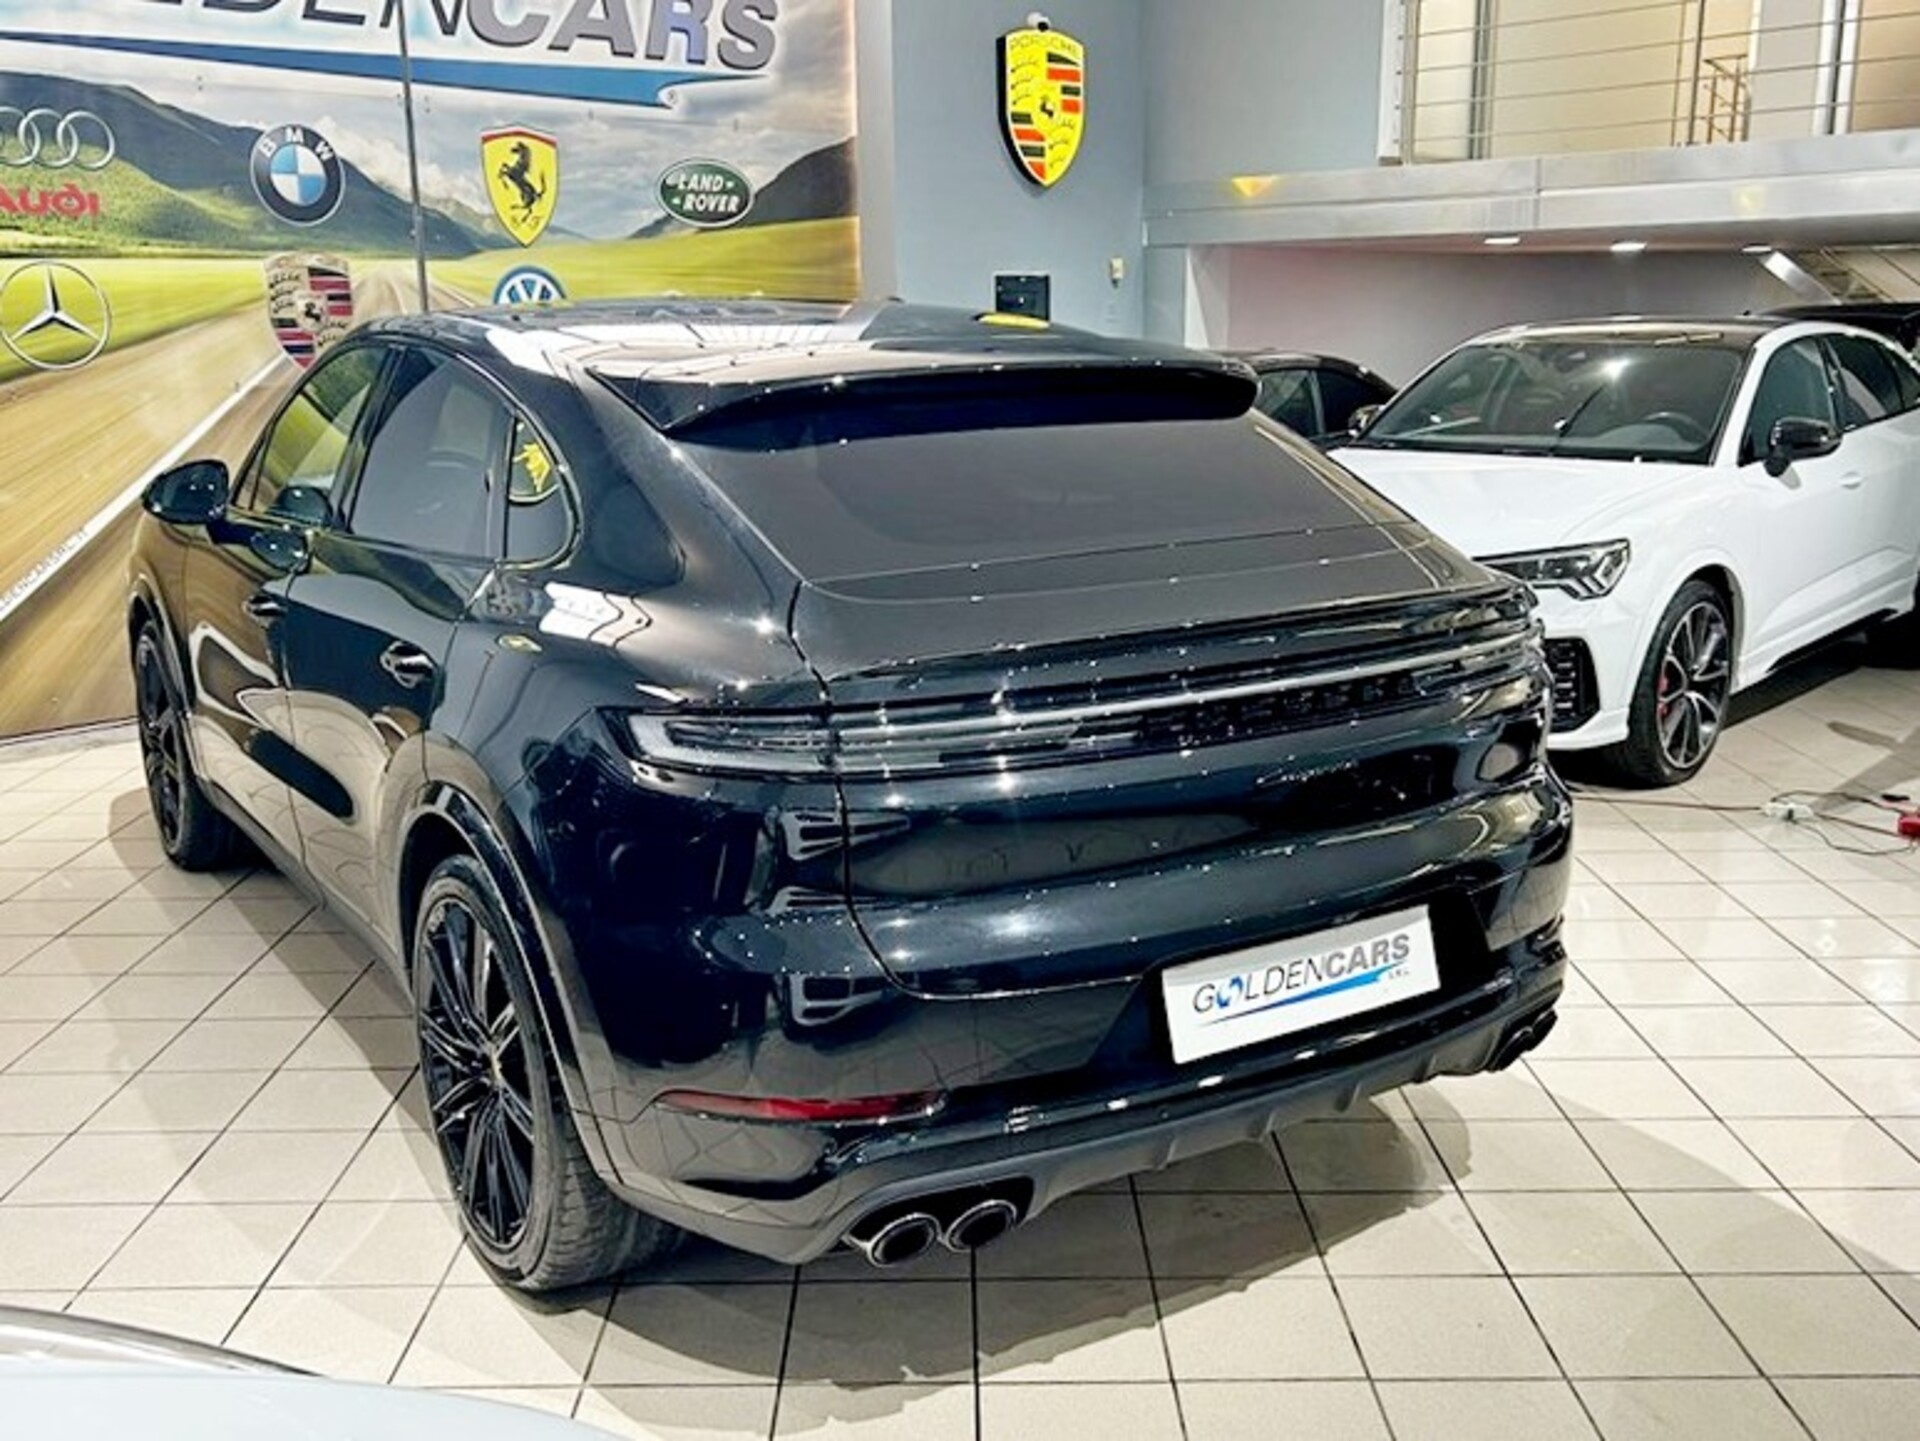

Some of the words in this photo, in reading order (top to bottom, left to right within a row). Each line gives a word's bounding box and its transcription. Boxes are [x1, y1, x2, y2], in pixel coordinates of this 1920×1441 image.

[257, 126, 335, 162] BMW
[677, 173, 725, 193] LAND
[682, 192, 741, 213] ROVER
[1191, 932, 1411, 1014] GOLDENCARS
